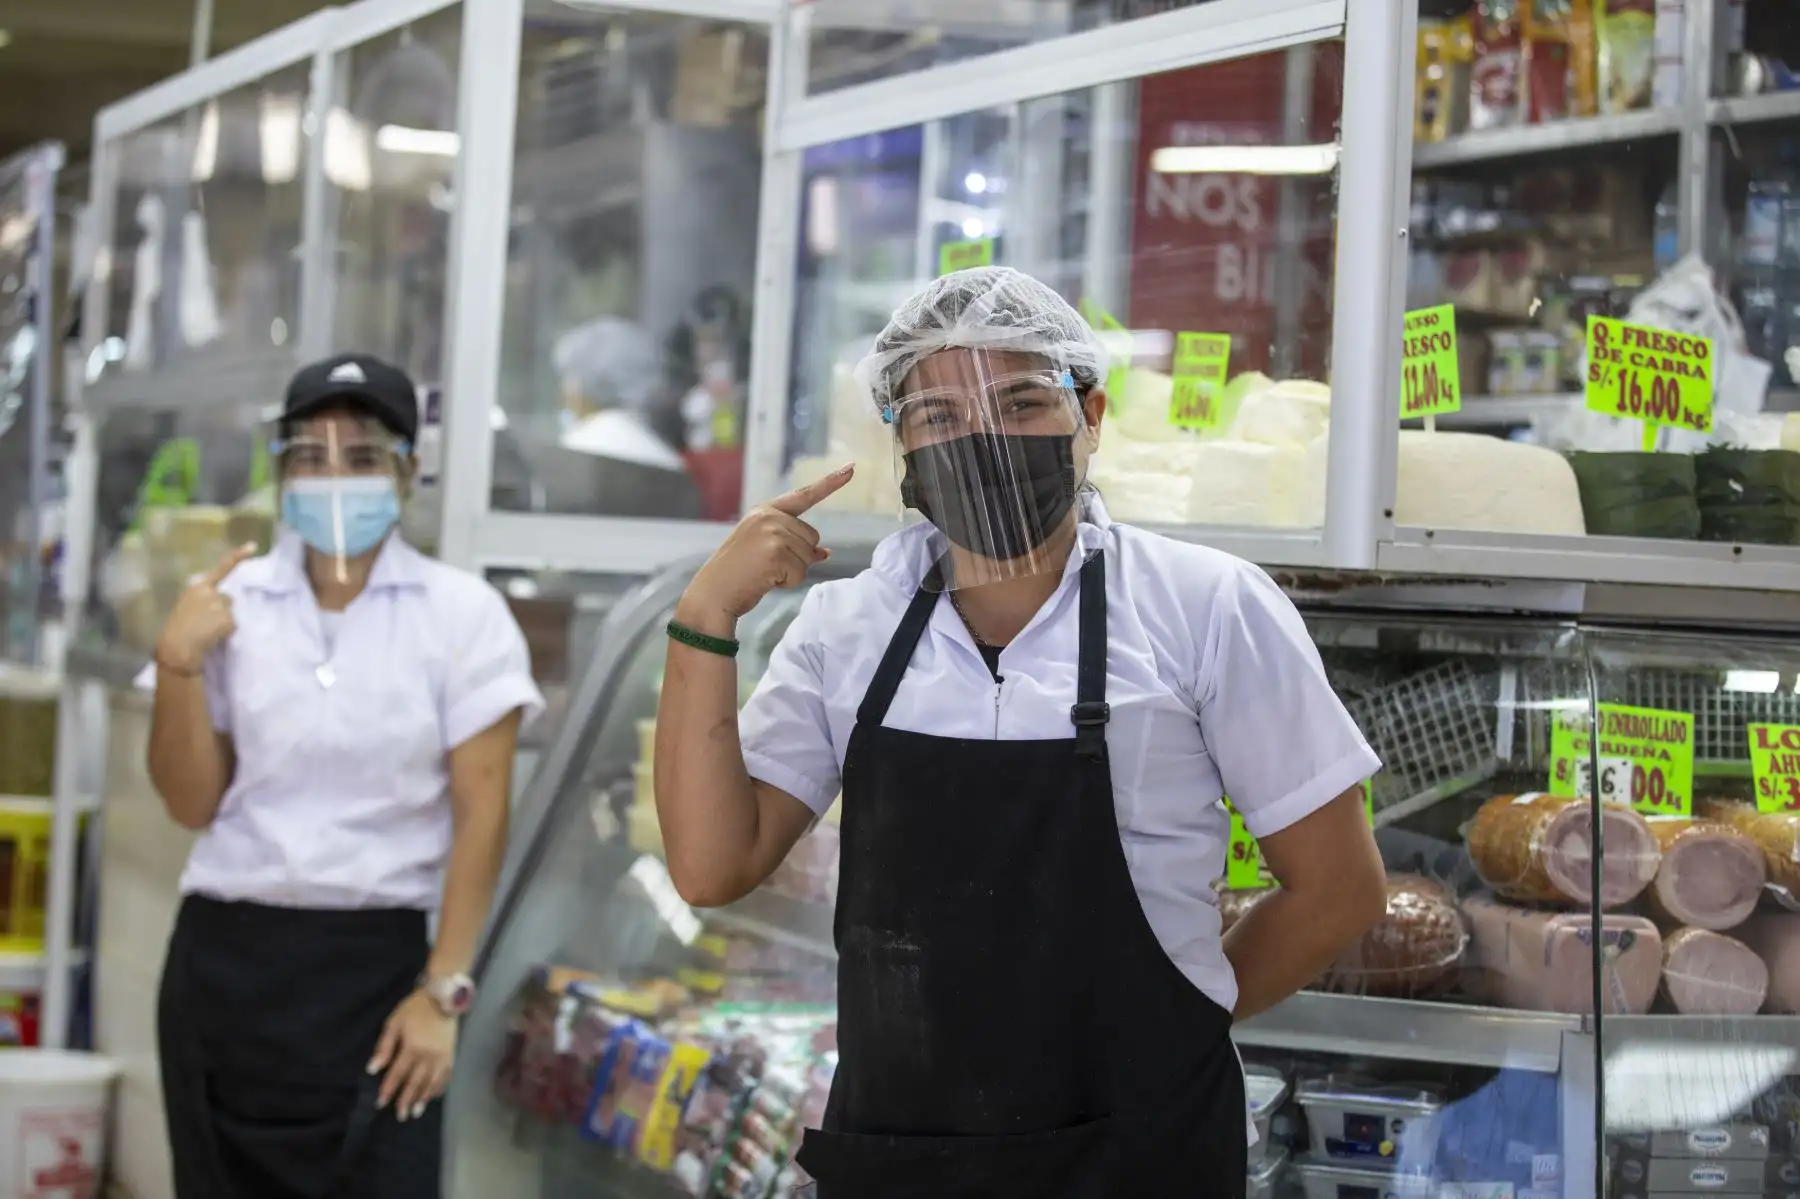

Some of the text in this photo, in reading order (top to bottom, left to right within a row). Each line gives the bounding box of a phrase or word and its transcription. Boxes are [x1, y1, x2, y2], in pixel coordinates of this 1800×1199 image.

[1403, 331, 1452, 358] RESCO
[1592, 321, 1709, 360] Q. FRESCO
[1593, 345, 1708, 381] DE CABRA
[1616, 367, 1681, 422] 16.00
